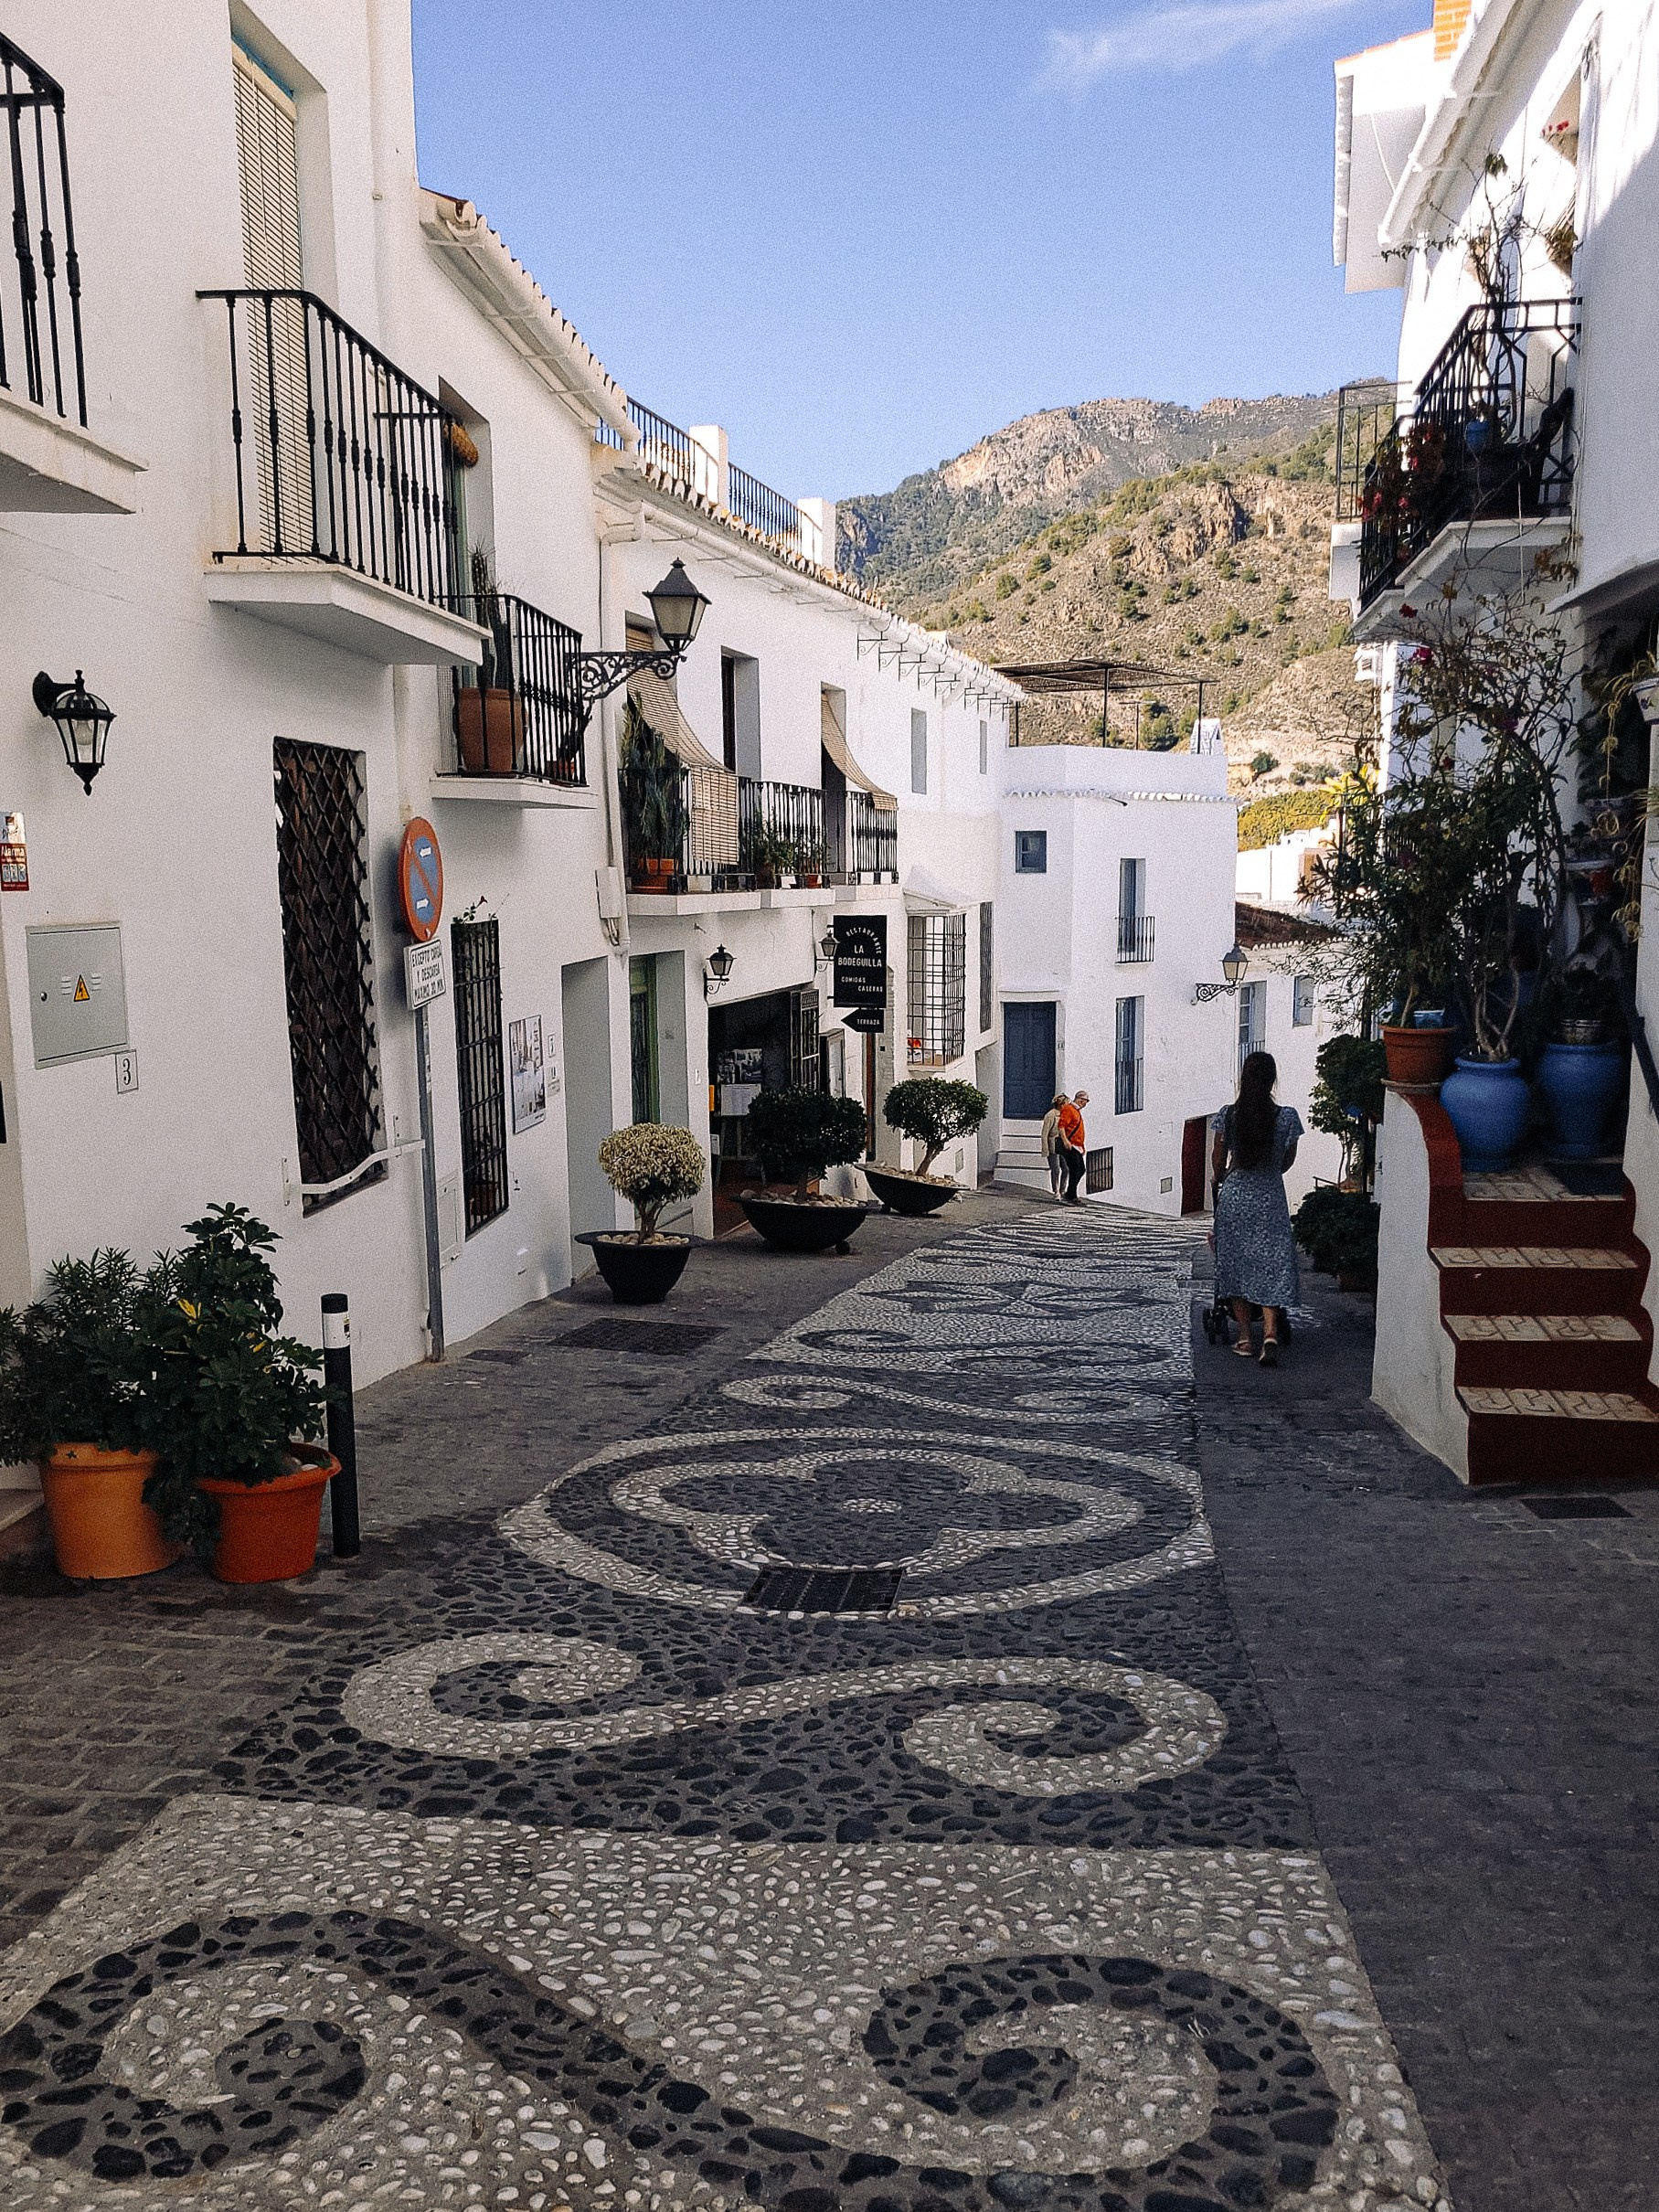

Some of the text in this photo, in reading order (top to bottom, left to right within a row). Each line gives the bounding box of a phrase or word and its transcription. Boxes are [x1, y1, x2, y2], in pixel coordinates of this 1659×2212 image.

[1, 845, 25, 856] Alarma
[845, 927, 882, 954] RESTAURANTE
[854, 944, 865, 954] LA
[412, 950, 430, 967] EXCEPTO
[838, 957, 882, 967] BODEGUILLA
[421, 962, 440, 981] DESCARGA
[122, 1058, 131, 1085] 3
